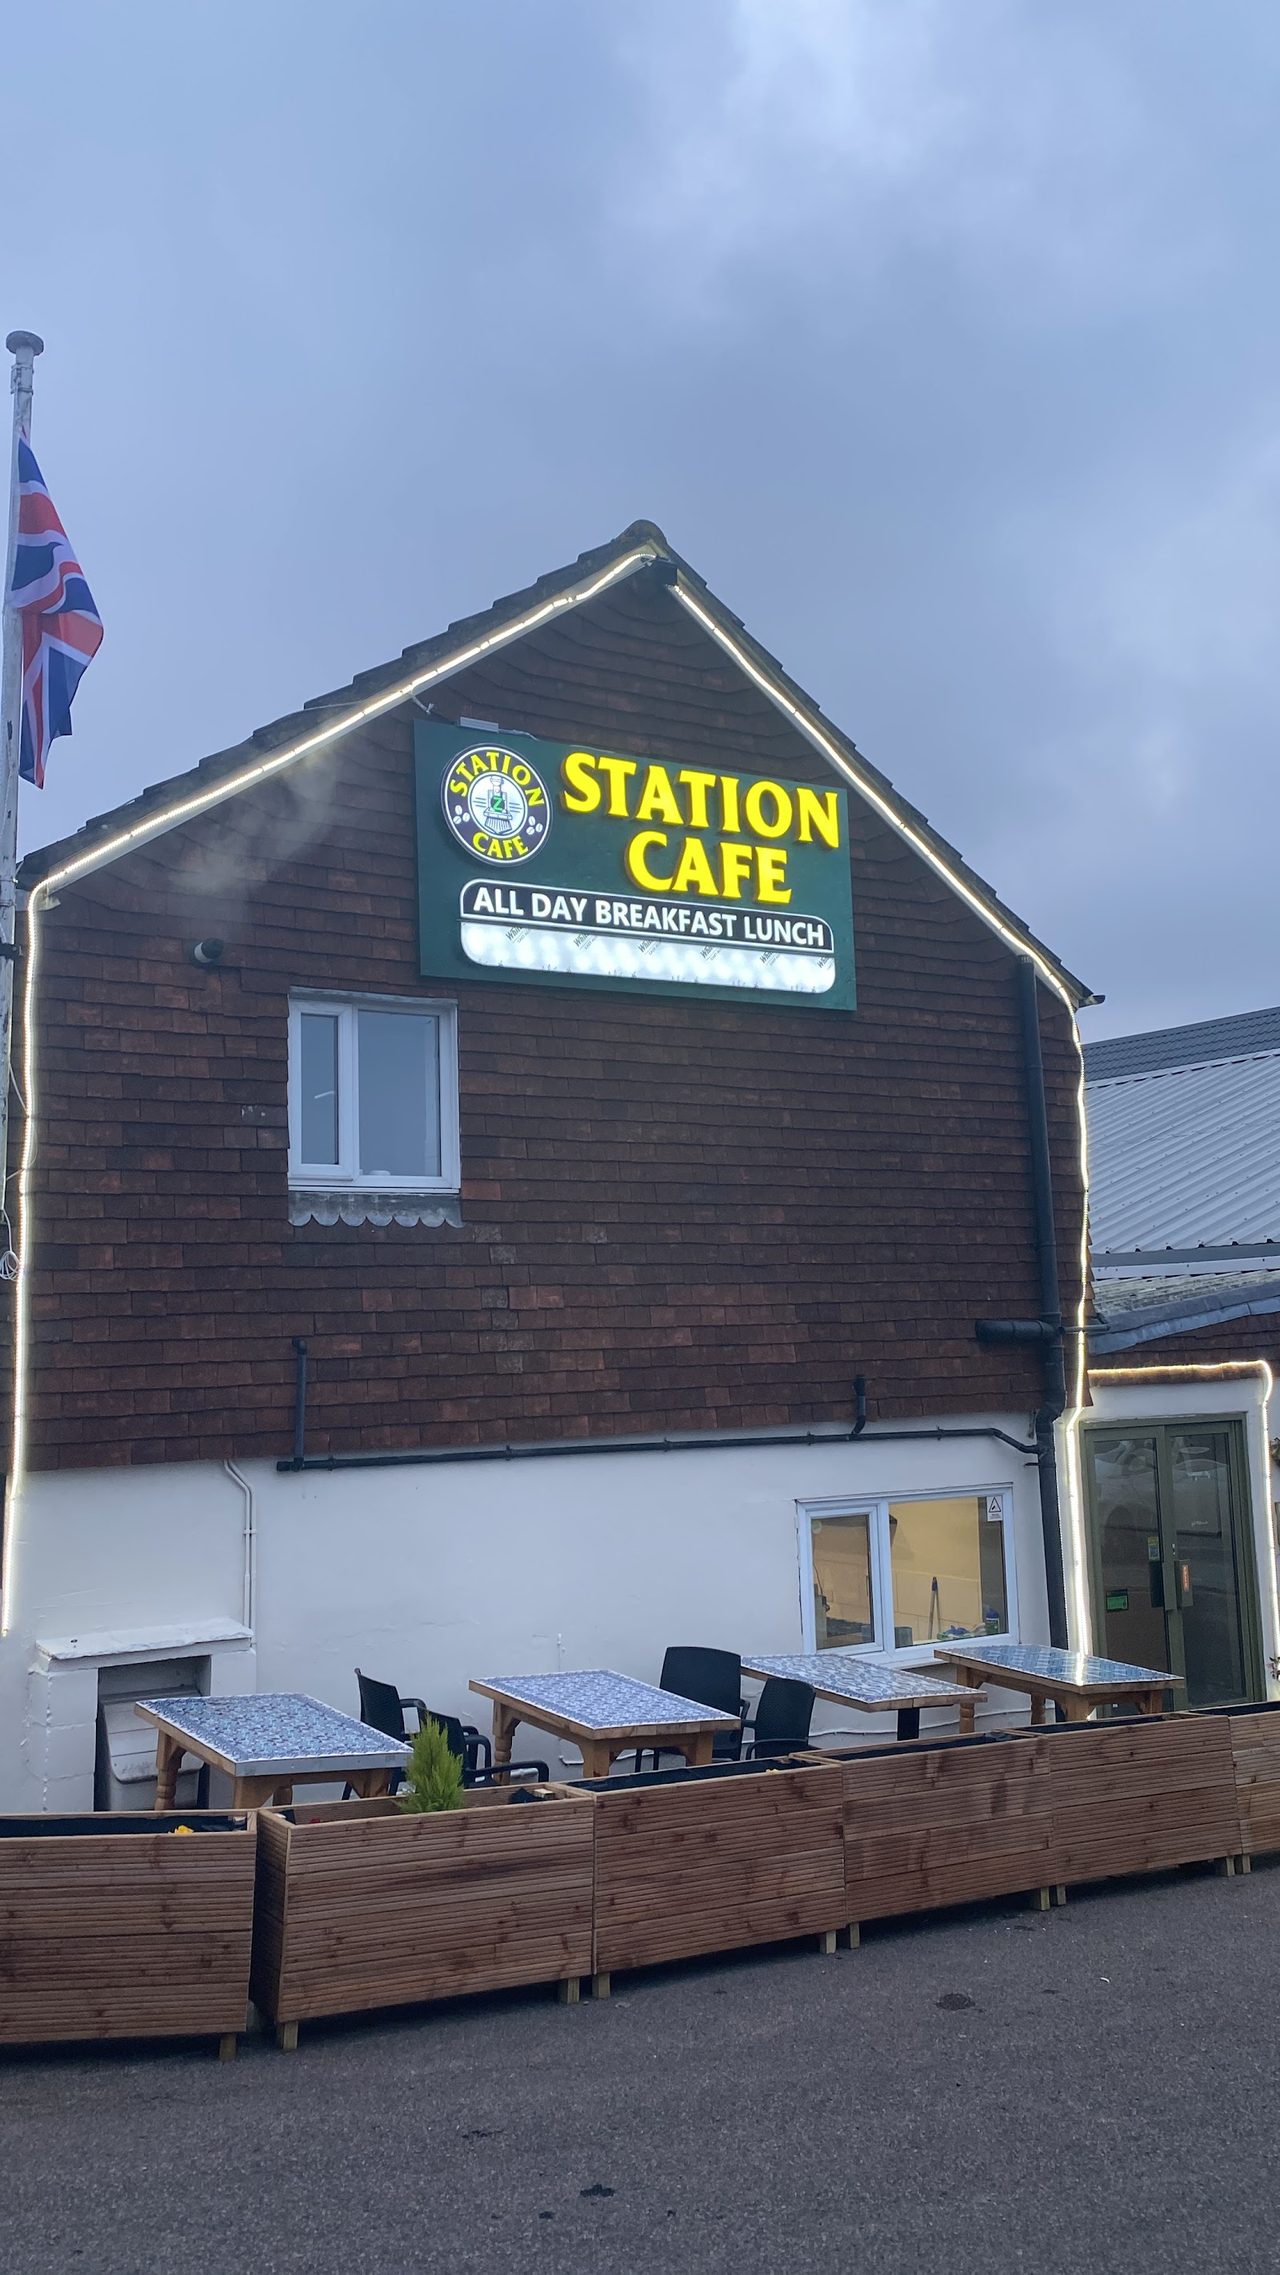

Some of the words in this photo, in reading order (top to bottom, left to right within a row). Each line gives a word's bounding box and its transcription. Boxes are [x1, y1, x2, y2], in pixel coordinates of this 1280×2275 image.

[449, 751, 545, 806] STATION
[564, 752, 839, 848] STATION
[472, 832, 529, 859] CAFE
[628, 830, 792, 904] CAFE
[473, 886, 525, 916] ALL
[531, 892, 588, 922] DAY
[596, 899, 737, 937] BREAKFAST
[744, 916, 824, 947] LUNCH
